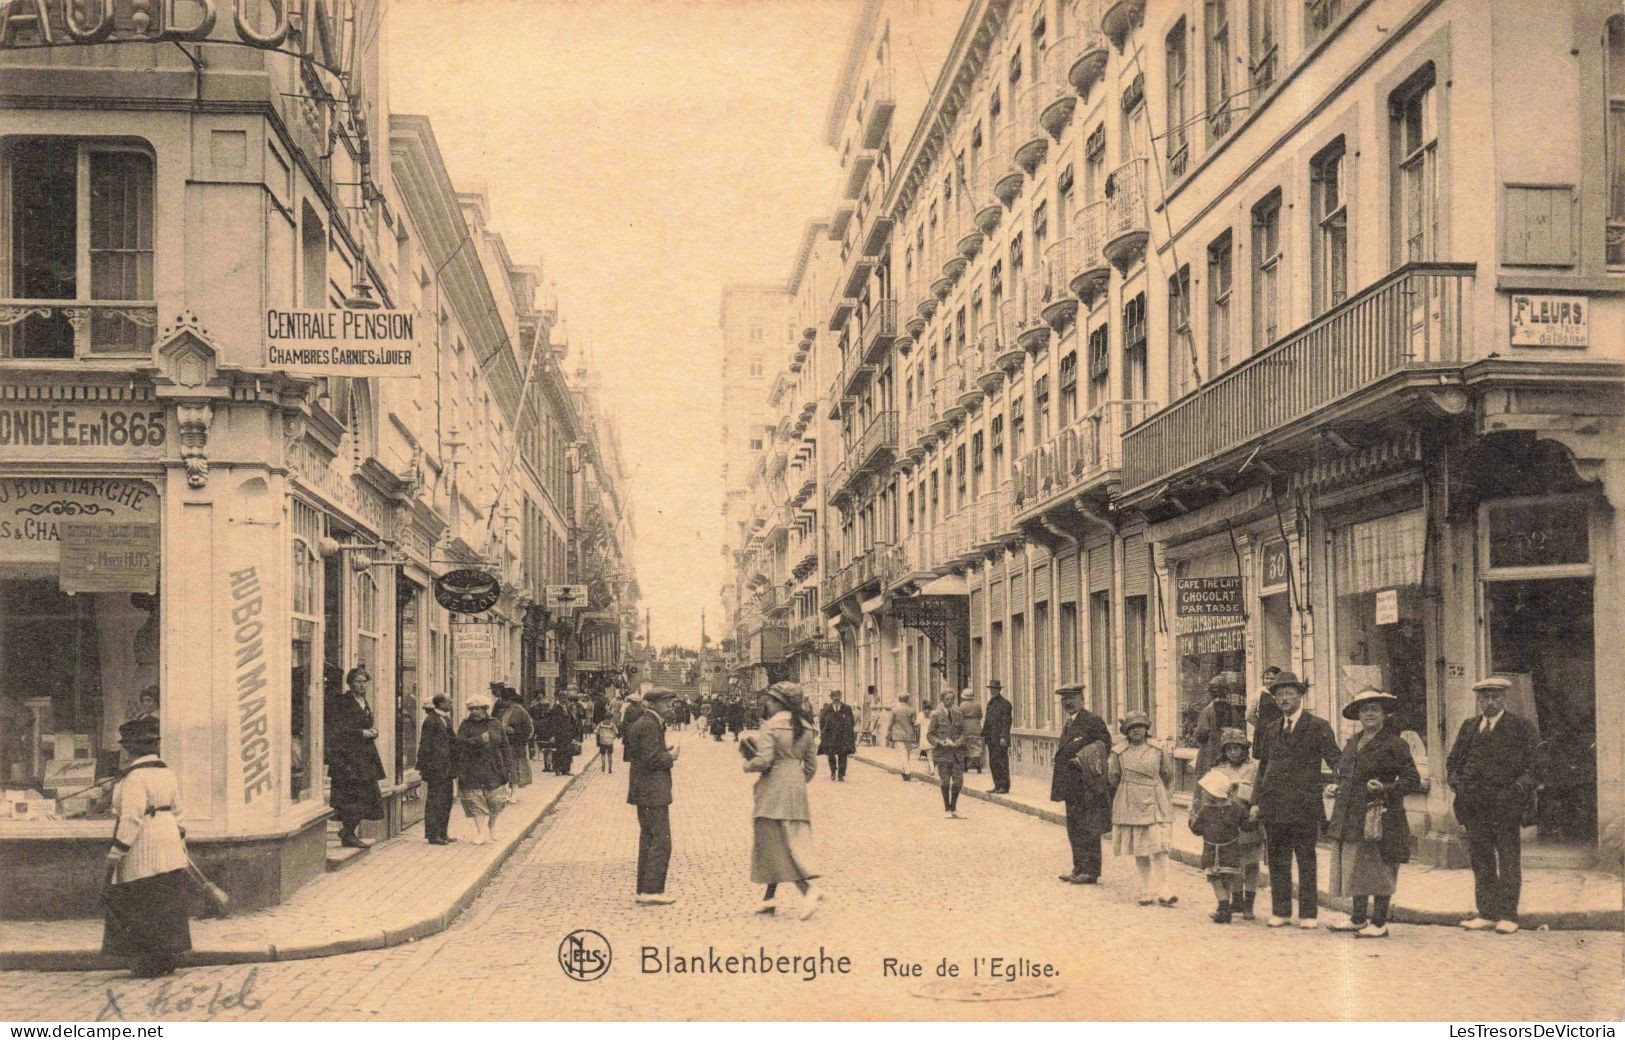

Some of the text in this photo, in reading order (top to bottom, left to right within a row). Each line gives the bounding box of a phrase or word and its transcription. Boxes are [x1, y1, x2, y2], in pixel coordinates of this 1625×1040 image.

[267, 309, 413, 340] CENTRALE PENSION
[269, 346, 330, 365] CHAMBRES
[381, 347, 411, 365] LOUER
[79, 424, 100, 446] EN
[100, 410, 166, 447] 1865
[1269, 552, 1285, 580] 30
[1220, 579, 1240, 588] LAIT
[1182, 604, 1239, 613] PAR TASSE
[1183, 591, 1235, 603] CHOCOLAT
[236, 661, 272, 805] MARCHE
